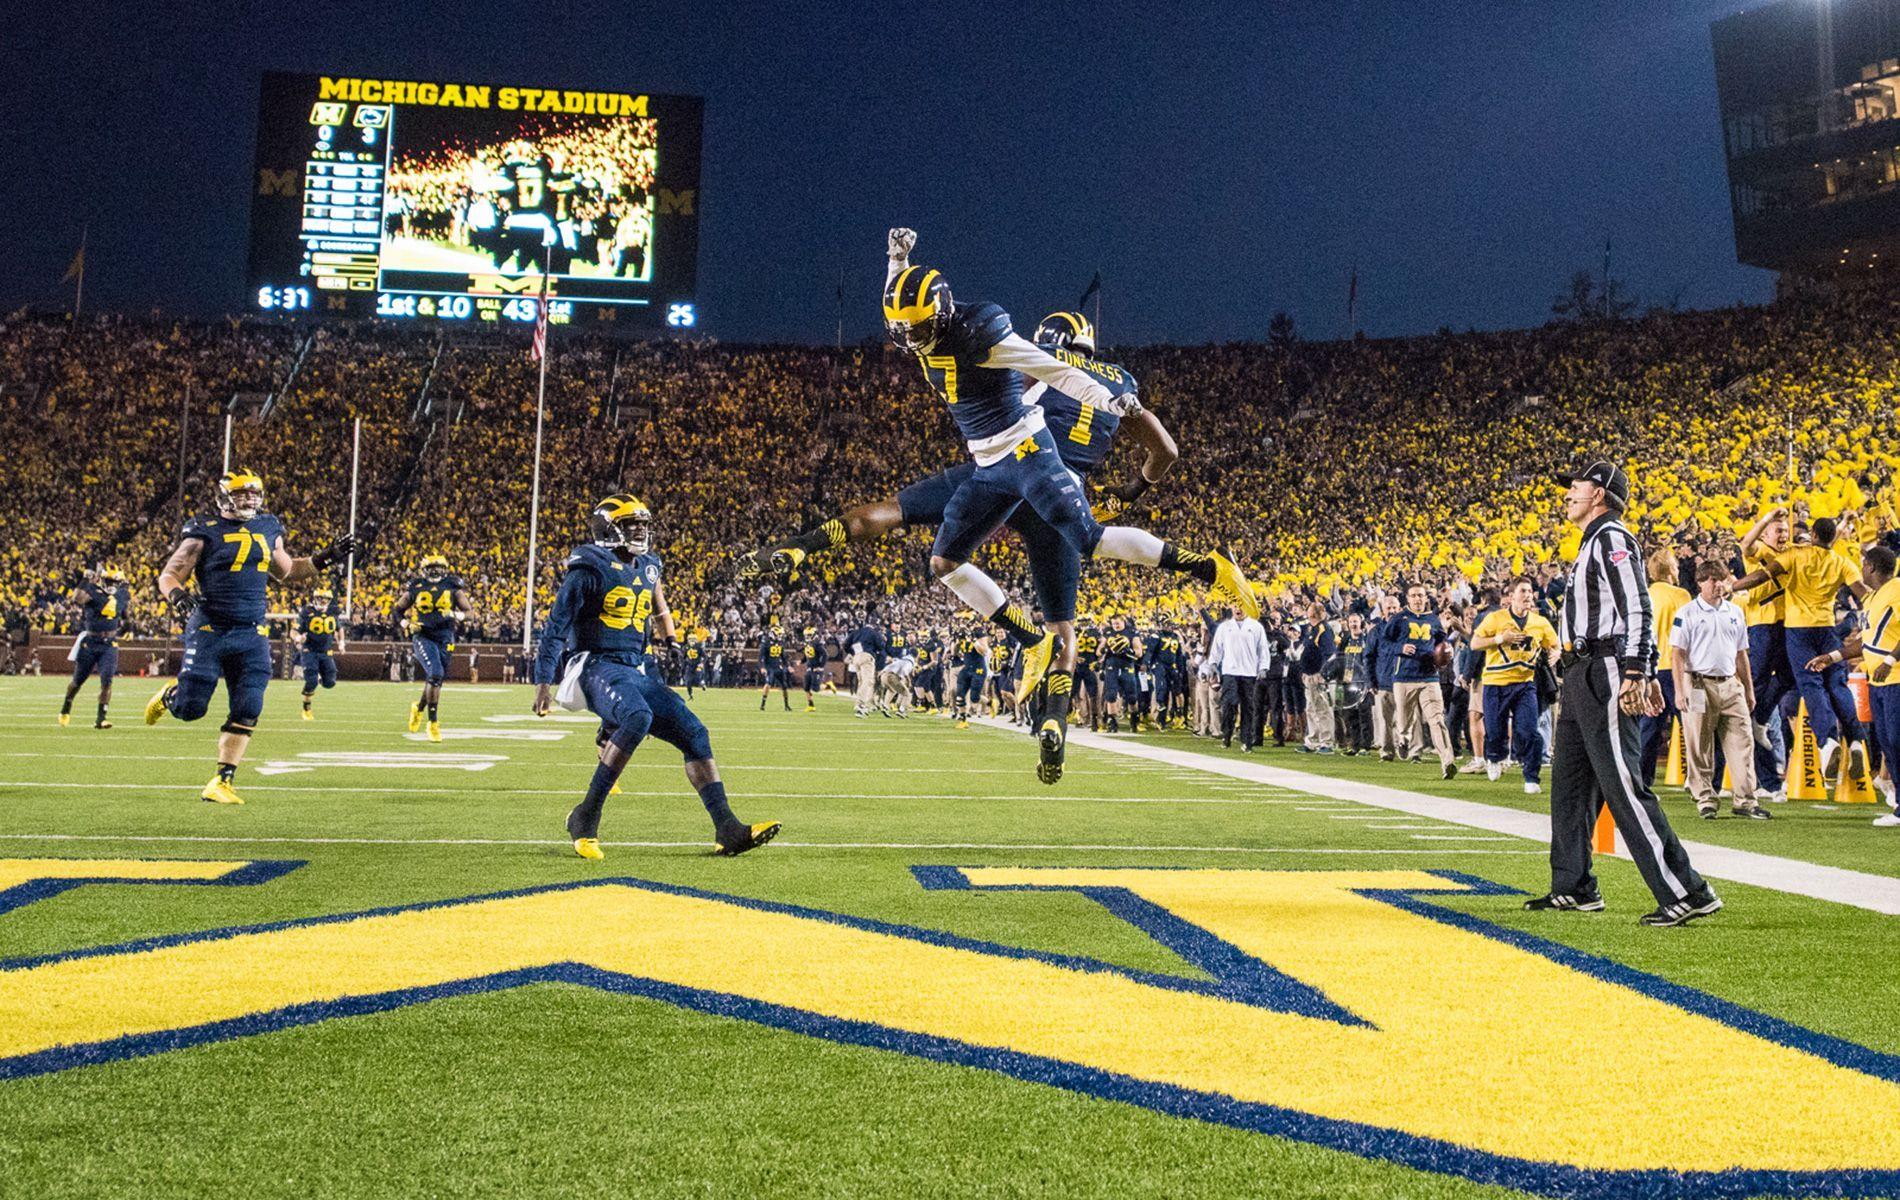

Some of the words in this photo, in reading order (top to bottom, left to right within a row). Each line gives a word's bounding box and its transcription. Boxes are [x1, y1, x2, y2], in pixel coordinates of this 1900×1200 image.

[319, 77, 491, 108] MICHIGAN
[498, 87, 649, 117] STADIUM
[318, 124, 333, 142] 0
[362, 127, 376, 144] 3
[259, 168, 298, 197] M
[656, 188, 696, 216] M
[467, 272, 559, 297] M
[257, 286, 310, 310] 6:37
[376, 293, 416, 317] 1st
[417, 297, 436, 316] &
[437, 296, 471, 318] 10
[476, 299, 502, 310] BALL
[502, 299, 536, 321] 43
[548, 301, 572, 314] 1st
[480, 310, 497, 321] ON
[667, 303, 695, 326] 25
[1055, 348, 1123, 385] FUNCHESS
[1068, 403, 1095, 447] 1
[1013, 436, 1041, 462] M
[222, 532, 272, 573] 71
[101, 595, 117, 619] 4
[415, 590, 453, 615] 84
[309, 616, 337, 635] 60
[1408, 621, 1432, 641] M
[1802, 715, 1816, 788] MICHIGAN
